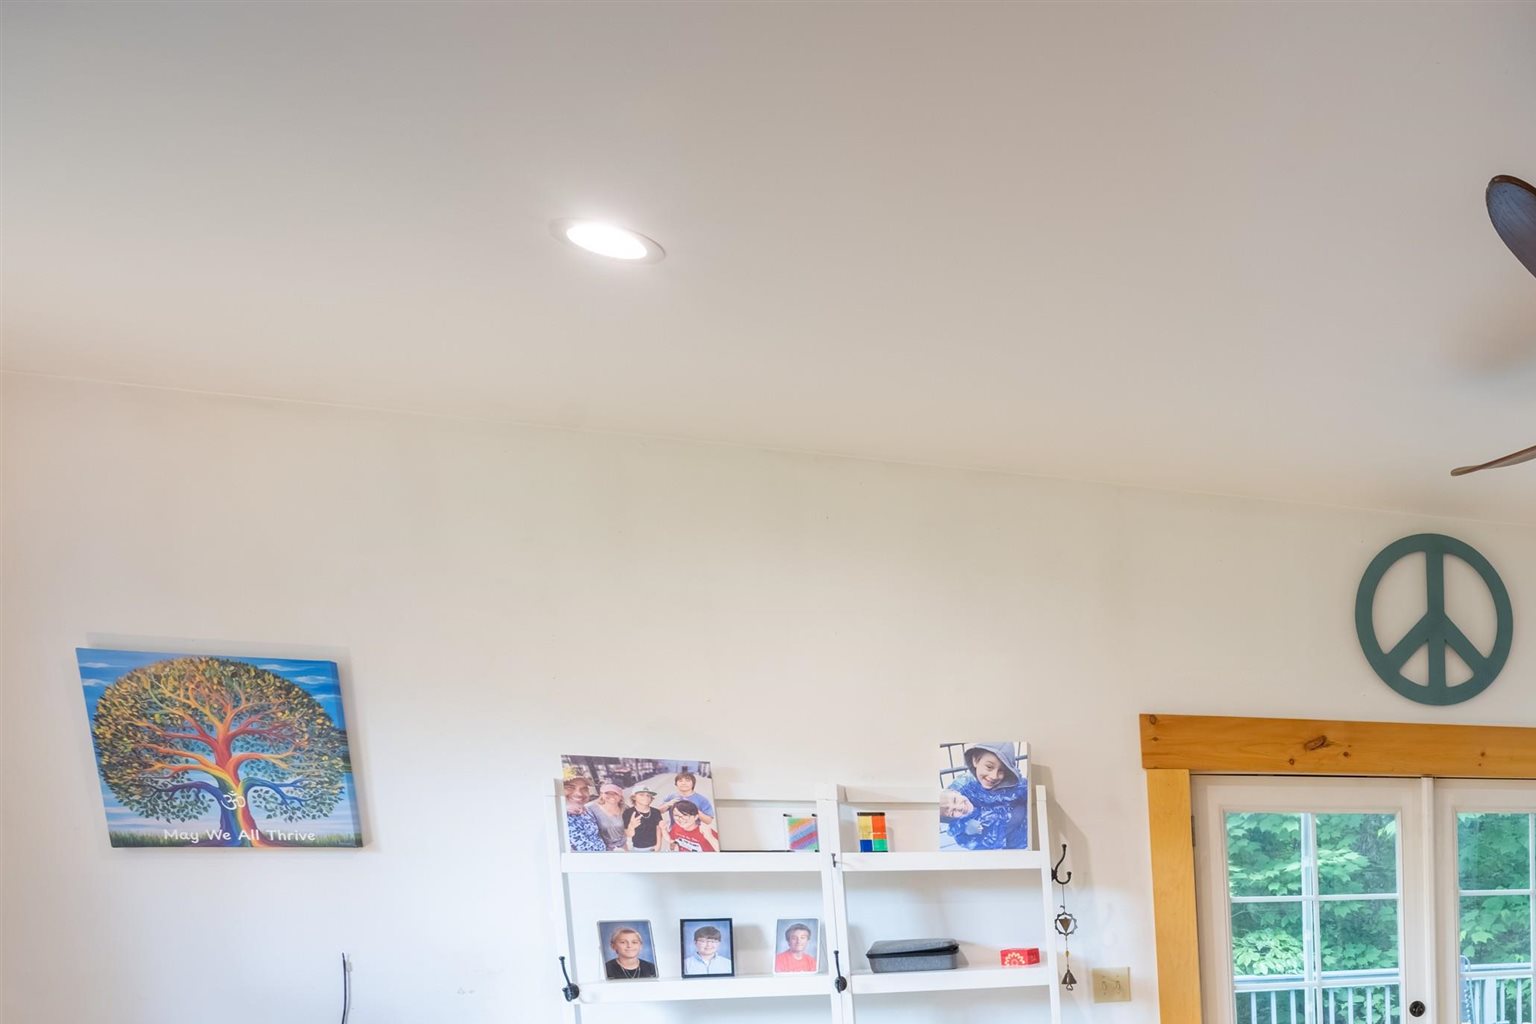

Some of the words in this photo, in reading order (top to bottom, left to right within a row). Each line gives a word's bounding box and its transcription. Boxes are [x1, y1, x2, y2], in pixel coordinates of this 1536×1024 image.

[163, 829, 199, 843] May
[206, 829, 231, 841] We
[238, 829, 260, 841] All
[266, 829, 316, 841] Thrive
